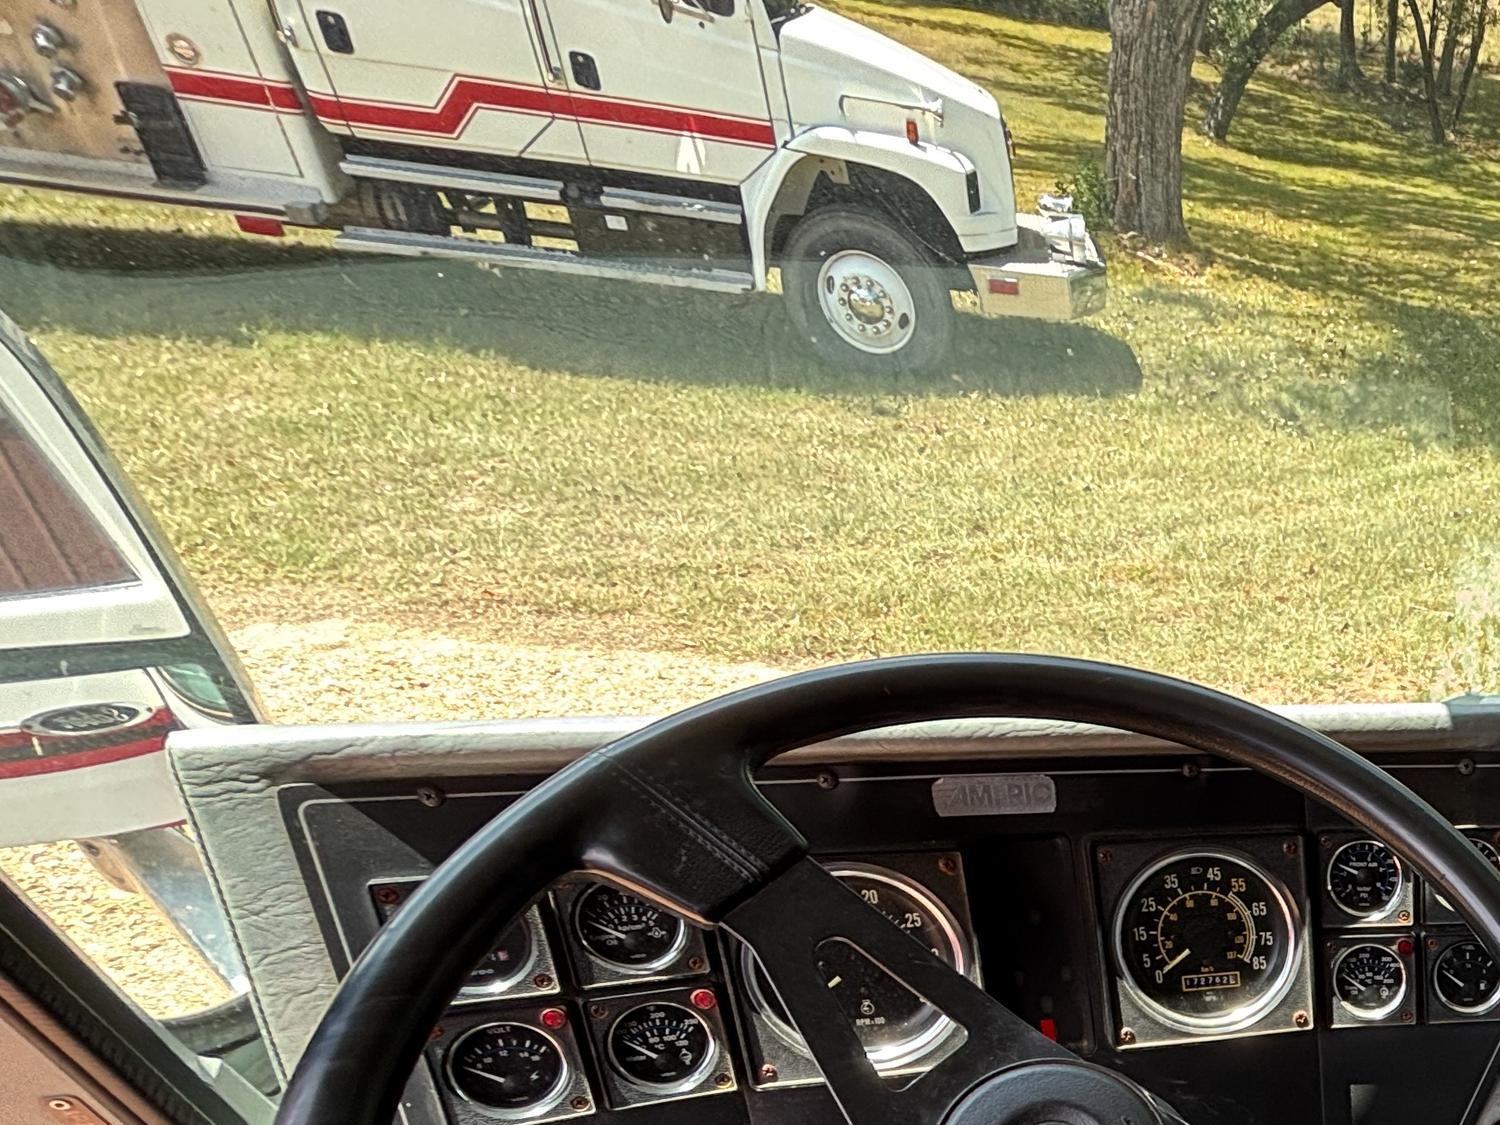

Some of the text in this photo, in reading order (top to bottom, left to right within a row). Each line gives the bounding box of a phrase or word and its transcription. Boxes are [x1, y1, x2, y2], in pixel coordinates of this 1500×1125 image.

[1206, 867, 1222, 881] 45
[1164, 874, 1179, 889] 35
[1231, 878, 1246, 892] 55
[1141, 897, 1156, 912] 25
[1252, 902, 1267, 916] 65
[905, 912, 922, 928] 25
[1134, 927, 1147, 941] 15
[1259, 932, 1273, 945] 75
[1143, 954, 1151, 968] 5
[1252, 956, 1267, 970] 85
[1155, 970, 1164, 984] 0
